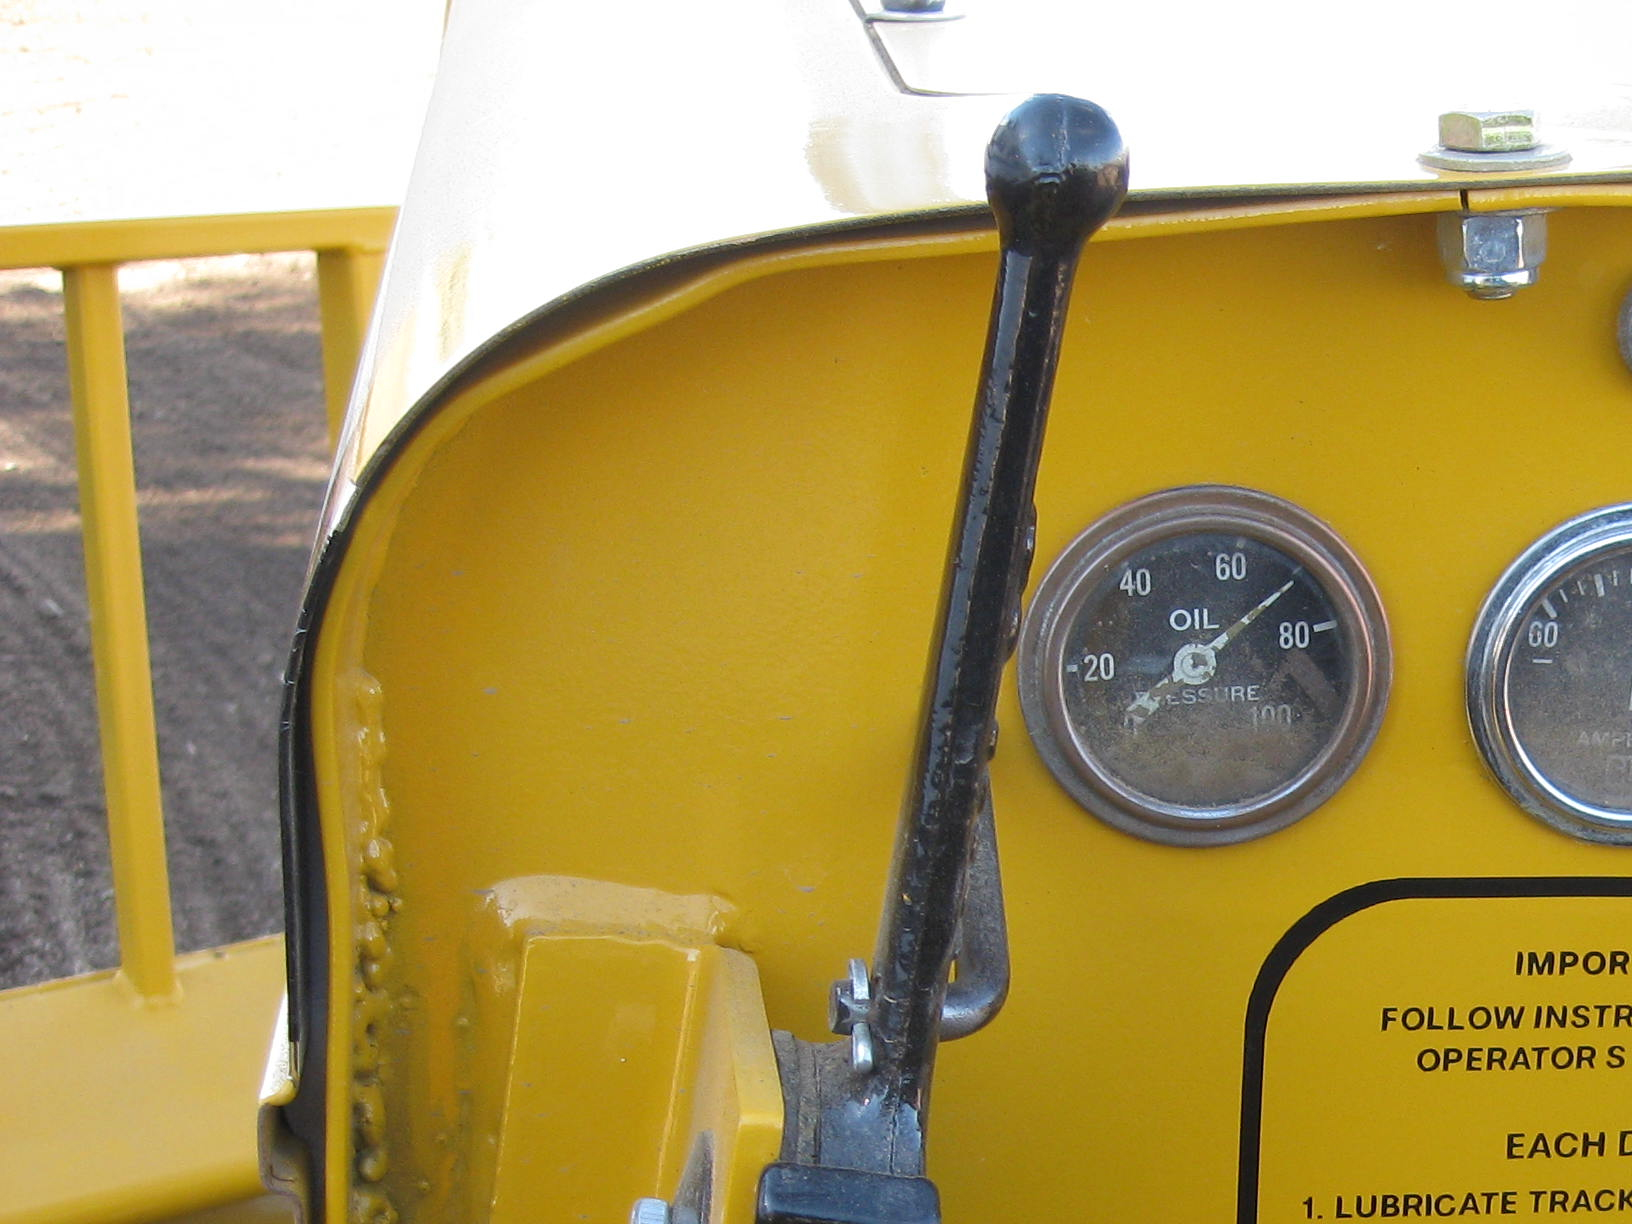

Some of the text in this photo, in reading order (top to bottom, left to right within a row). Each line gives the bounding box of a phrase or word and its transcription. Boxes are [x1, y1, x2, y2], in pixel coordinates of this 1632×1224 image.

[1215, 553, 1247, 580] 60
[1119, 569, 1152, 596] 40
[1169, 608, 1220, 631] OIL
[1278, 621, 1310, 649] 80
[1528, 621, 1558, 648] 60
[1083, 653, 1115, 681] 20
[1381, 1006, 1525, 1032] FOLLOW
[1417, 1045, 1597, 1072] OPERATOR
[1606, 1045, 1626, 1069] S
[1506, 1131, 1606, 1160] EACH
[1302, 1196, 1323, 1220] 1.
[1335, 1191, 1518, 1219] LUBRICATE
